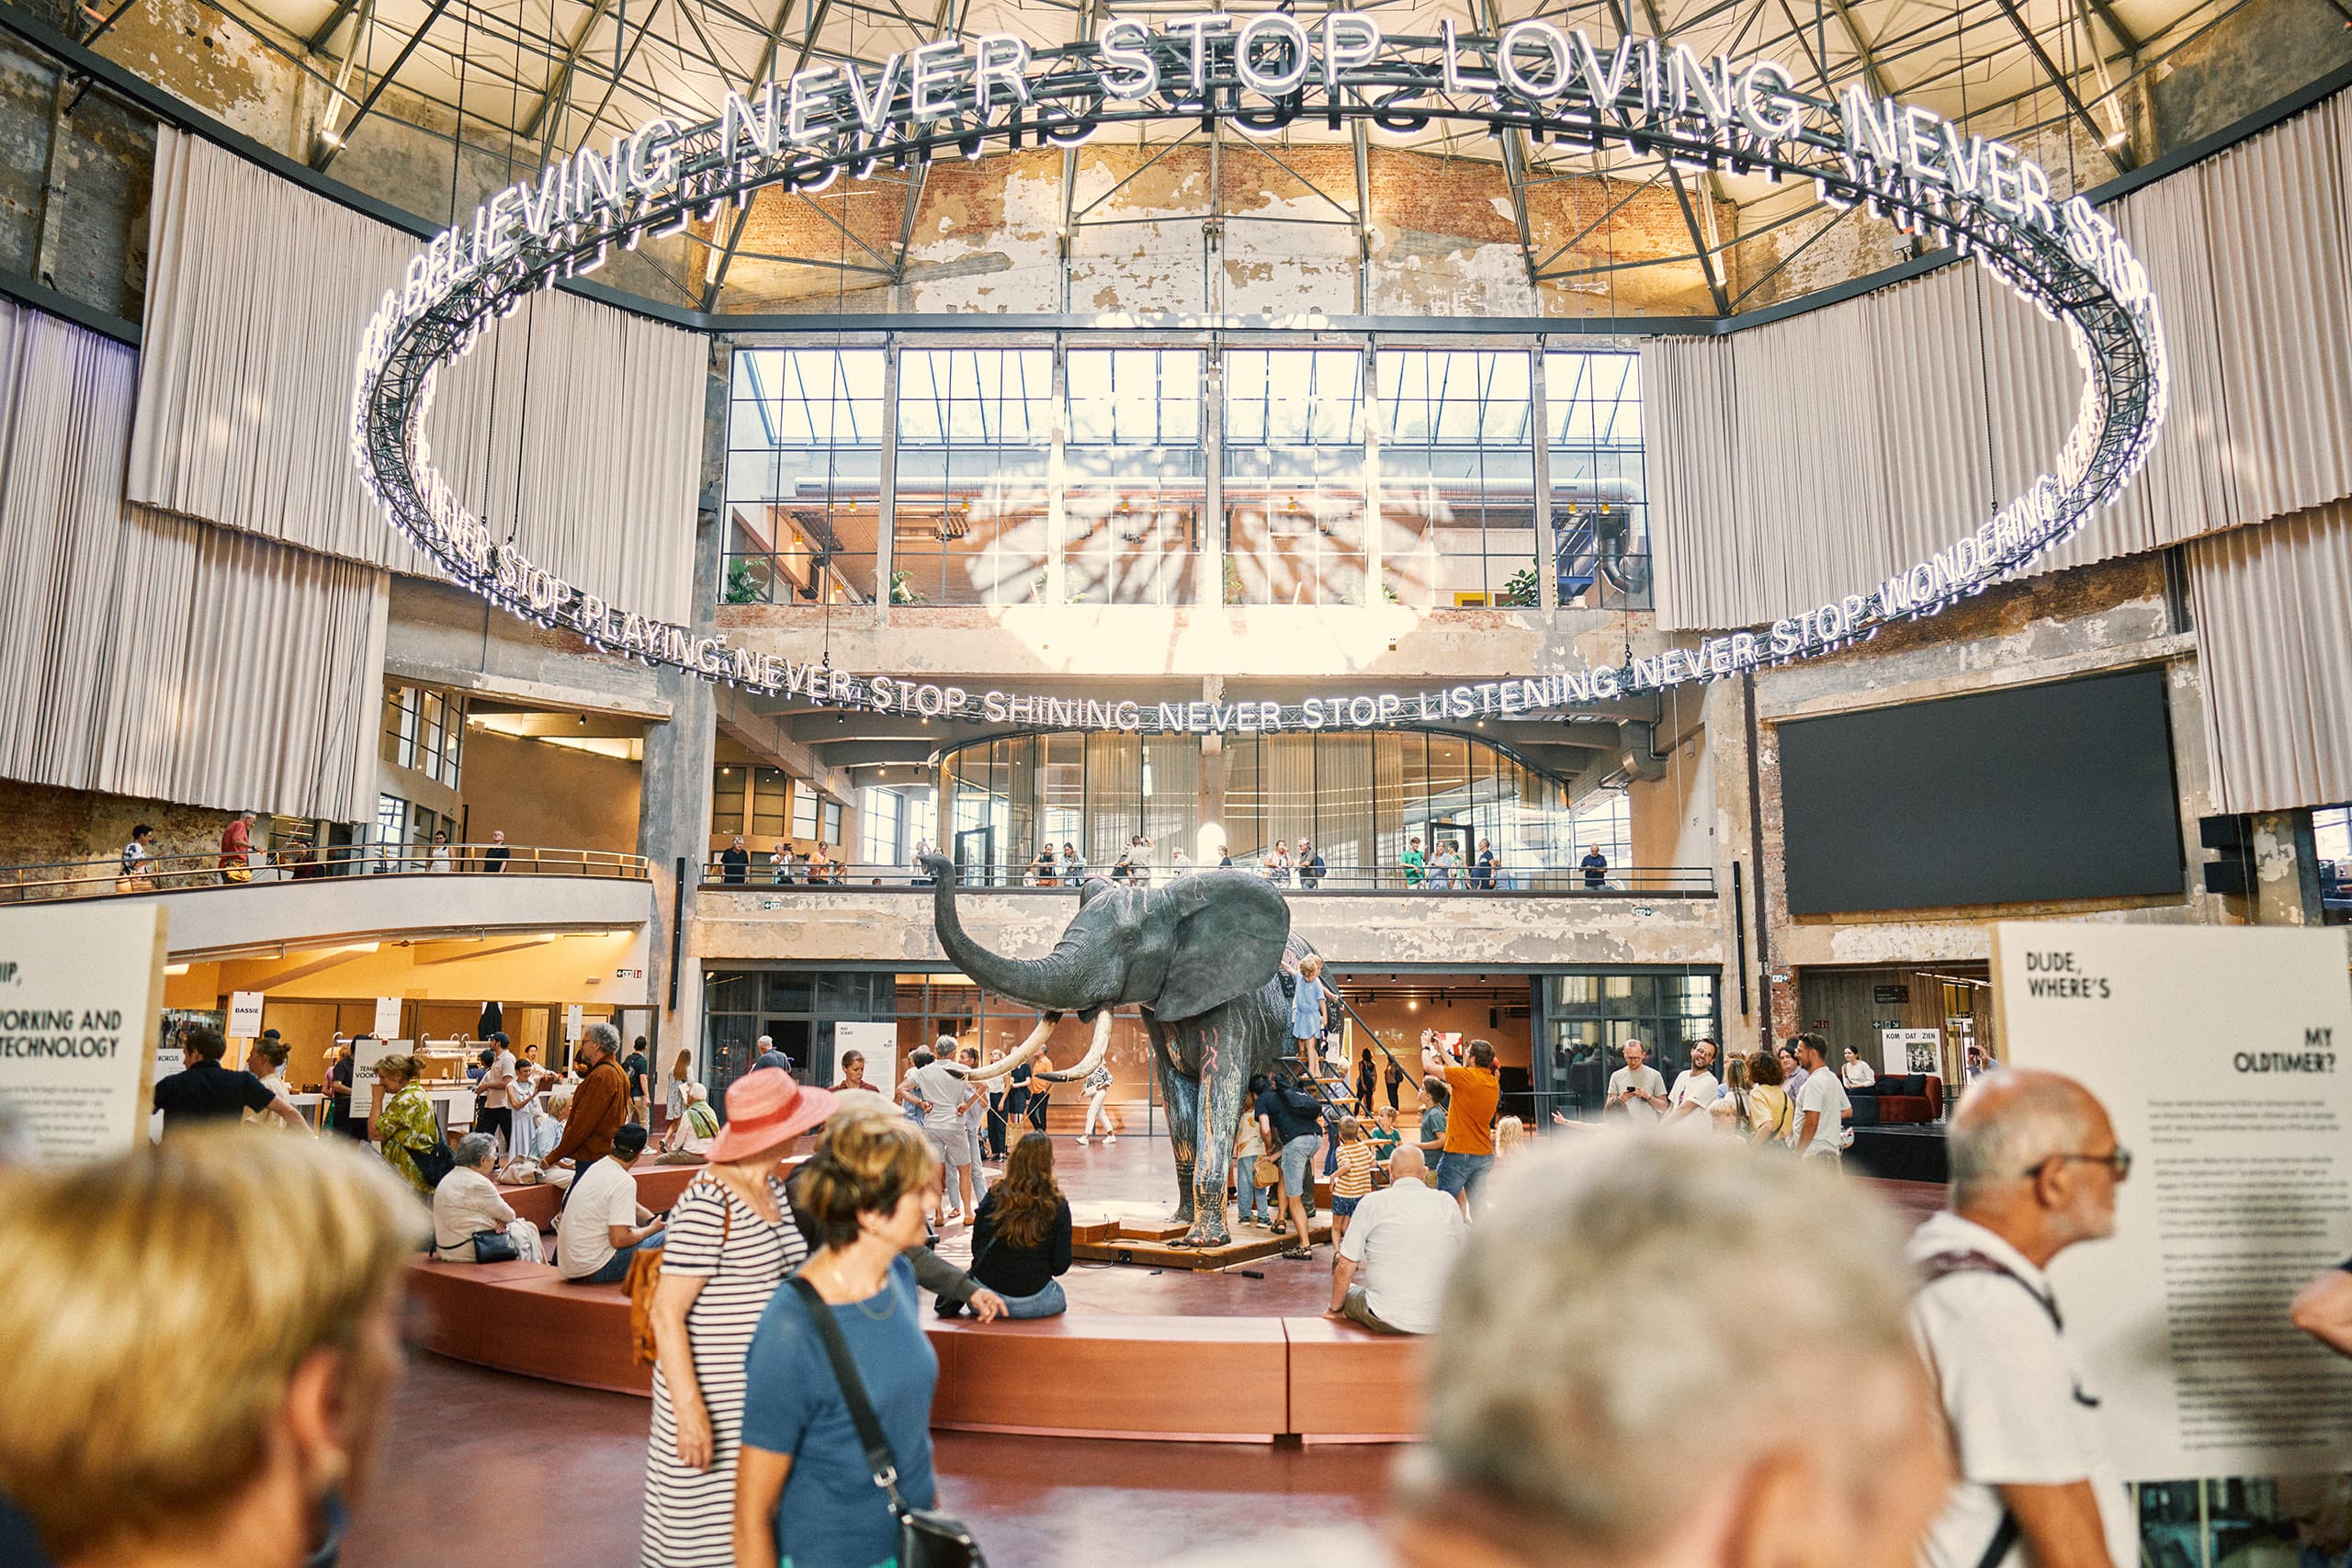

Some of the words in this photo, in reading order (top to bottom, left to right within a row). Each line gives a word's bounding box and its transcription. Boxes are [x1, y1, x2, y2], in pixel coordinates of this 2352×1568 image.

[402, 116, 682, 318] BELIEVING
[720, 32, 1034, 159] NEVER
[1100, 12, 1381, 98] STOP
[1442, 18, 1801, 140] LOVING
[1839, 85, 2056, 232] NEVER
[2064, 195, 2148, 314] STOP
[497, 545, 571, 620] STOP
[582, 595, 720, 673] PLAYING
[735, 647, 853, 702] NEVER
[869, 676, 967, 716] STOP
[983, 691, 1140, 731] SHINING
[1158, 702, 1282, 733] NEVER
[1301, 693, 1402, 729] STOP
[1419, 665, 1620, 721] LISTENING
[1633, 631, 1758, 691] NEVER
[1770, 594, 1868, 655] STOP
[1879, 472, 2055, 616] WONDERING
[2026, 951, 2083, 974] DUDE,
[2029, 977, 2111, 999] WHERE'S
[80, 1010, 121, 1031] AND
[0, 1036, 119, 1057] TECHNOLOGY
[2304, 1026, 2334, 1049] MY
[2233, 1052, 2335, 1073] OLDTIMER?
